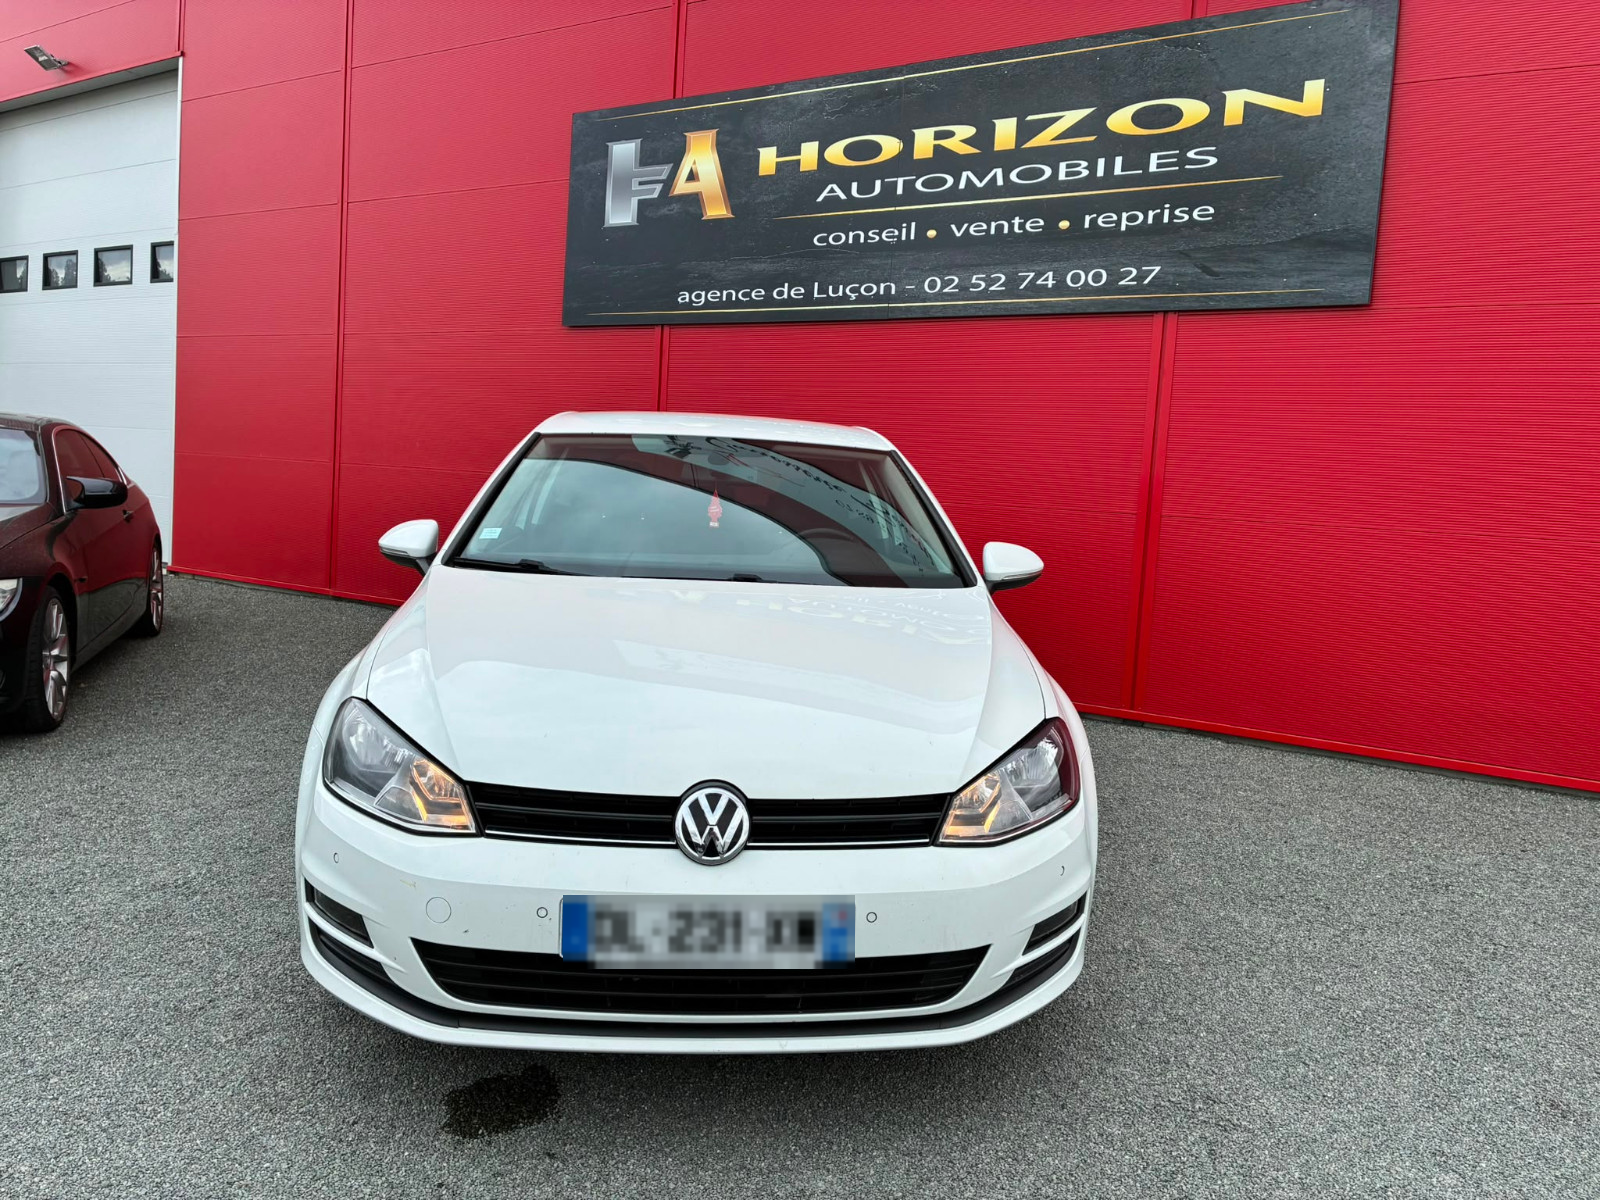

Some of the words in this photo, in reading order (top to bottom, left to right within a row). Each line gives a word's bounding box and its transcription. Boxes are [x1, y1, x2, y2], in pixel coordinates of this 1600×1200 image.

[757, 78, 1326, 176] HORIZON
[815, 146, 1219, 203] AUTOMOBILES
[812, 221, 917, 247] conseil
[950, 216, 1046, 238] vente
[1083, 203, 1216, 232] reprise
[676, 287, 766, 307] agence
[772, 282, 806, 300] de
[812, 281, 897, 302] Luçon
[923, 275, 960, 294] 02
[969, 273, 1007, 292] 52
[1017, 270, 1057, 290] 74
[1065, 268, 1108, 288] 00
[1117, 265, 1162, 286] 27
